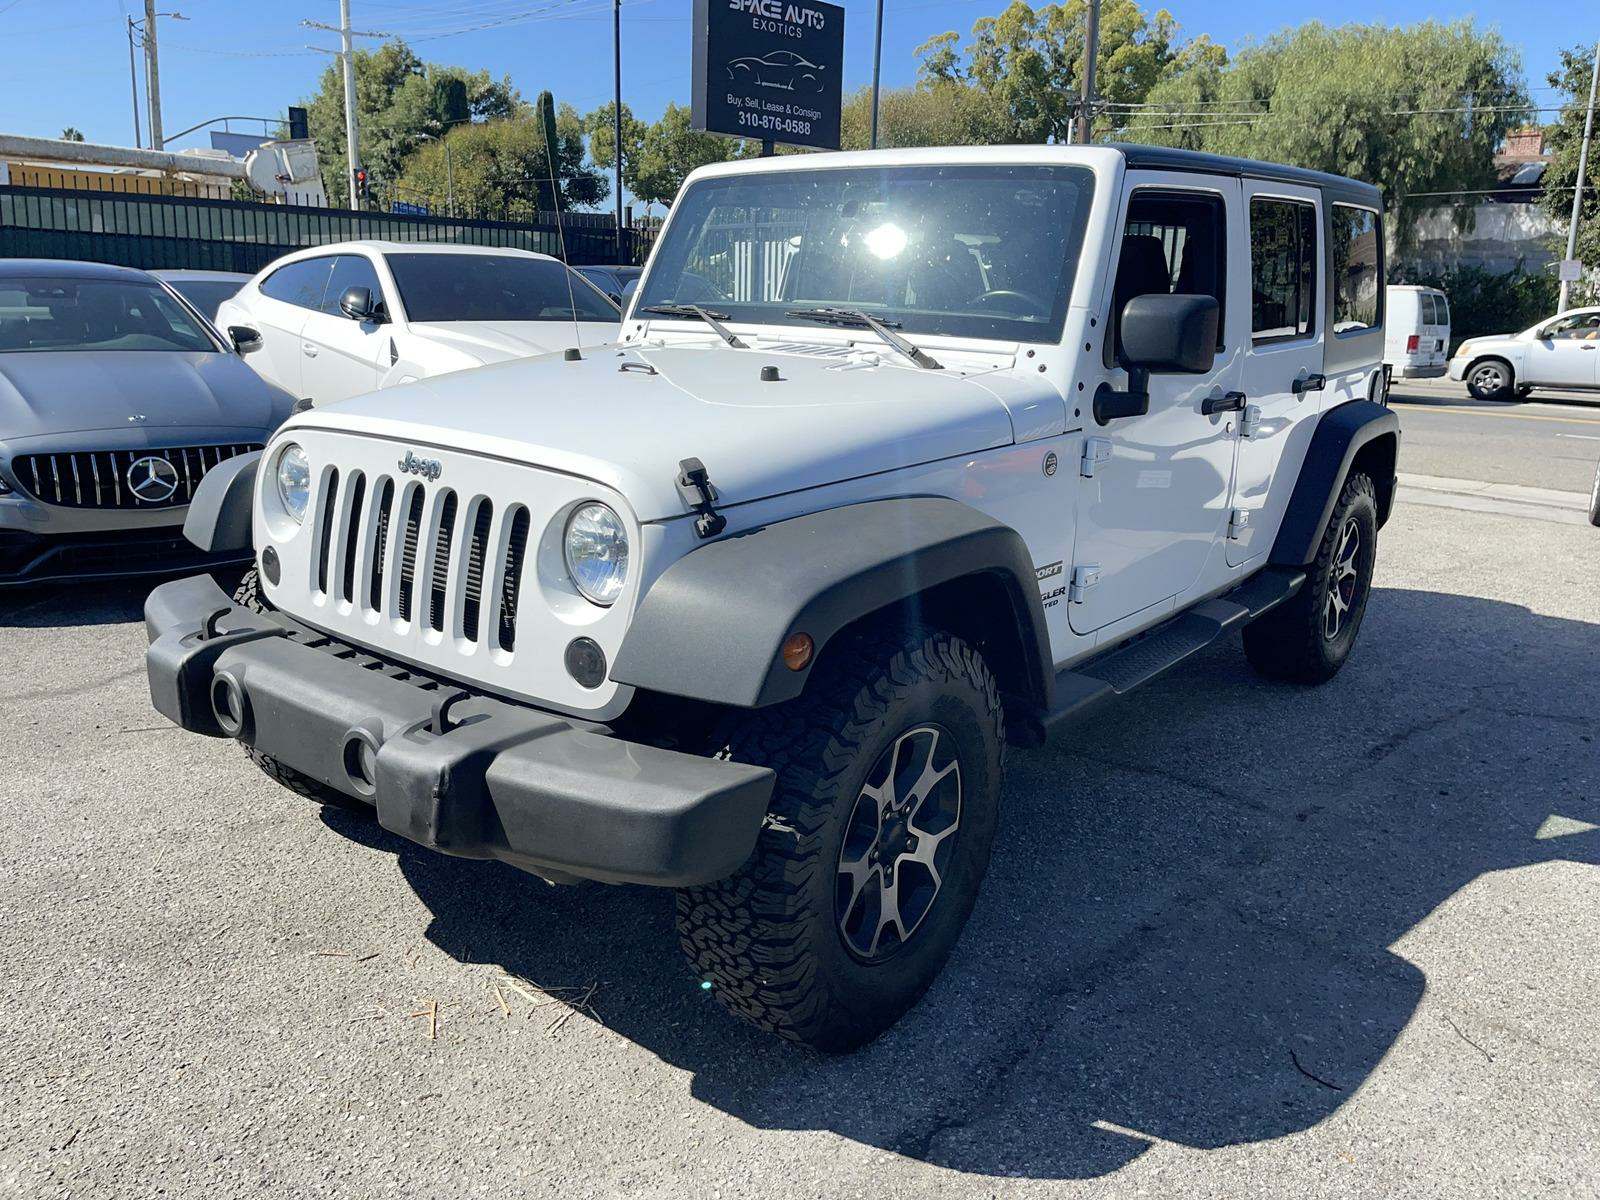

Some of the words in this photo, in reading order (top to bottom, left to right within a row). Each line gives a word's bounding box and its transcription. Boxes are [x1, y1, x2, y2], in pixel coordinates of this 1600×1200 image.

[752, 17, 802, 38] EXOTICS
[784, 4, 825, 30] AUTO
[727, 93, 743, 107] Buy,
[744, 96, 761, 109] Sell,
[762, 99, 785, 113] Lease
[785, 103, 792, 114] &
[792, 105, 822, 121] Consign
[738, 111, 811, 135] 310-876-0588
[397, 449, 443, 483] Jeep
